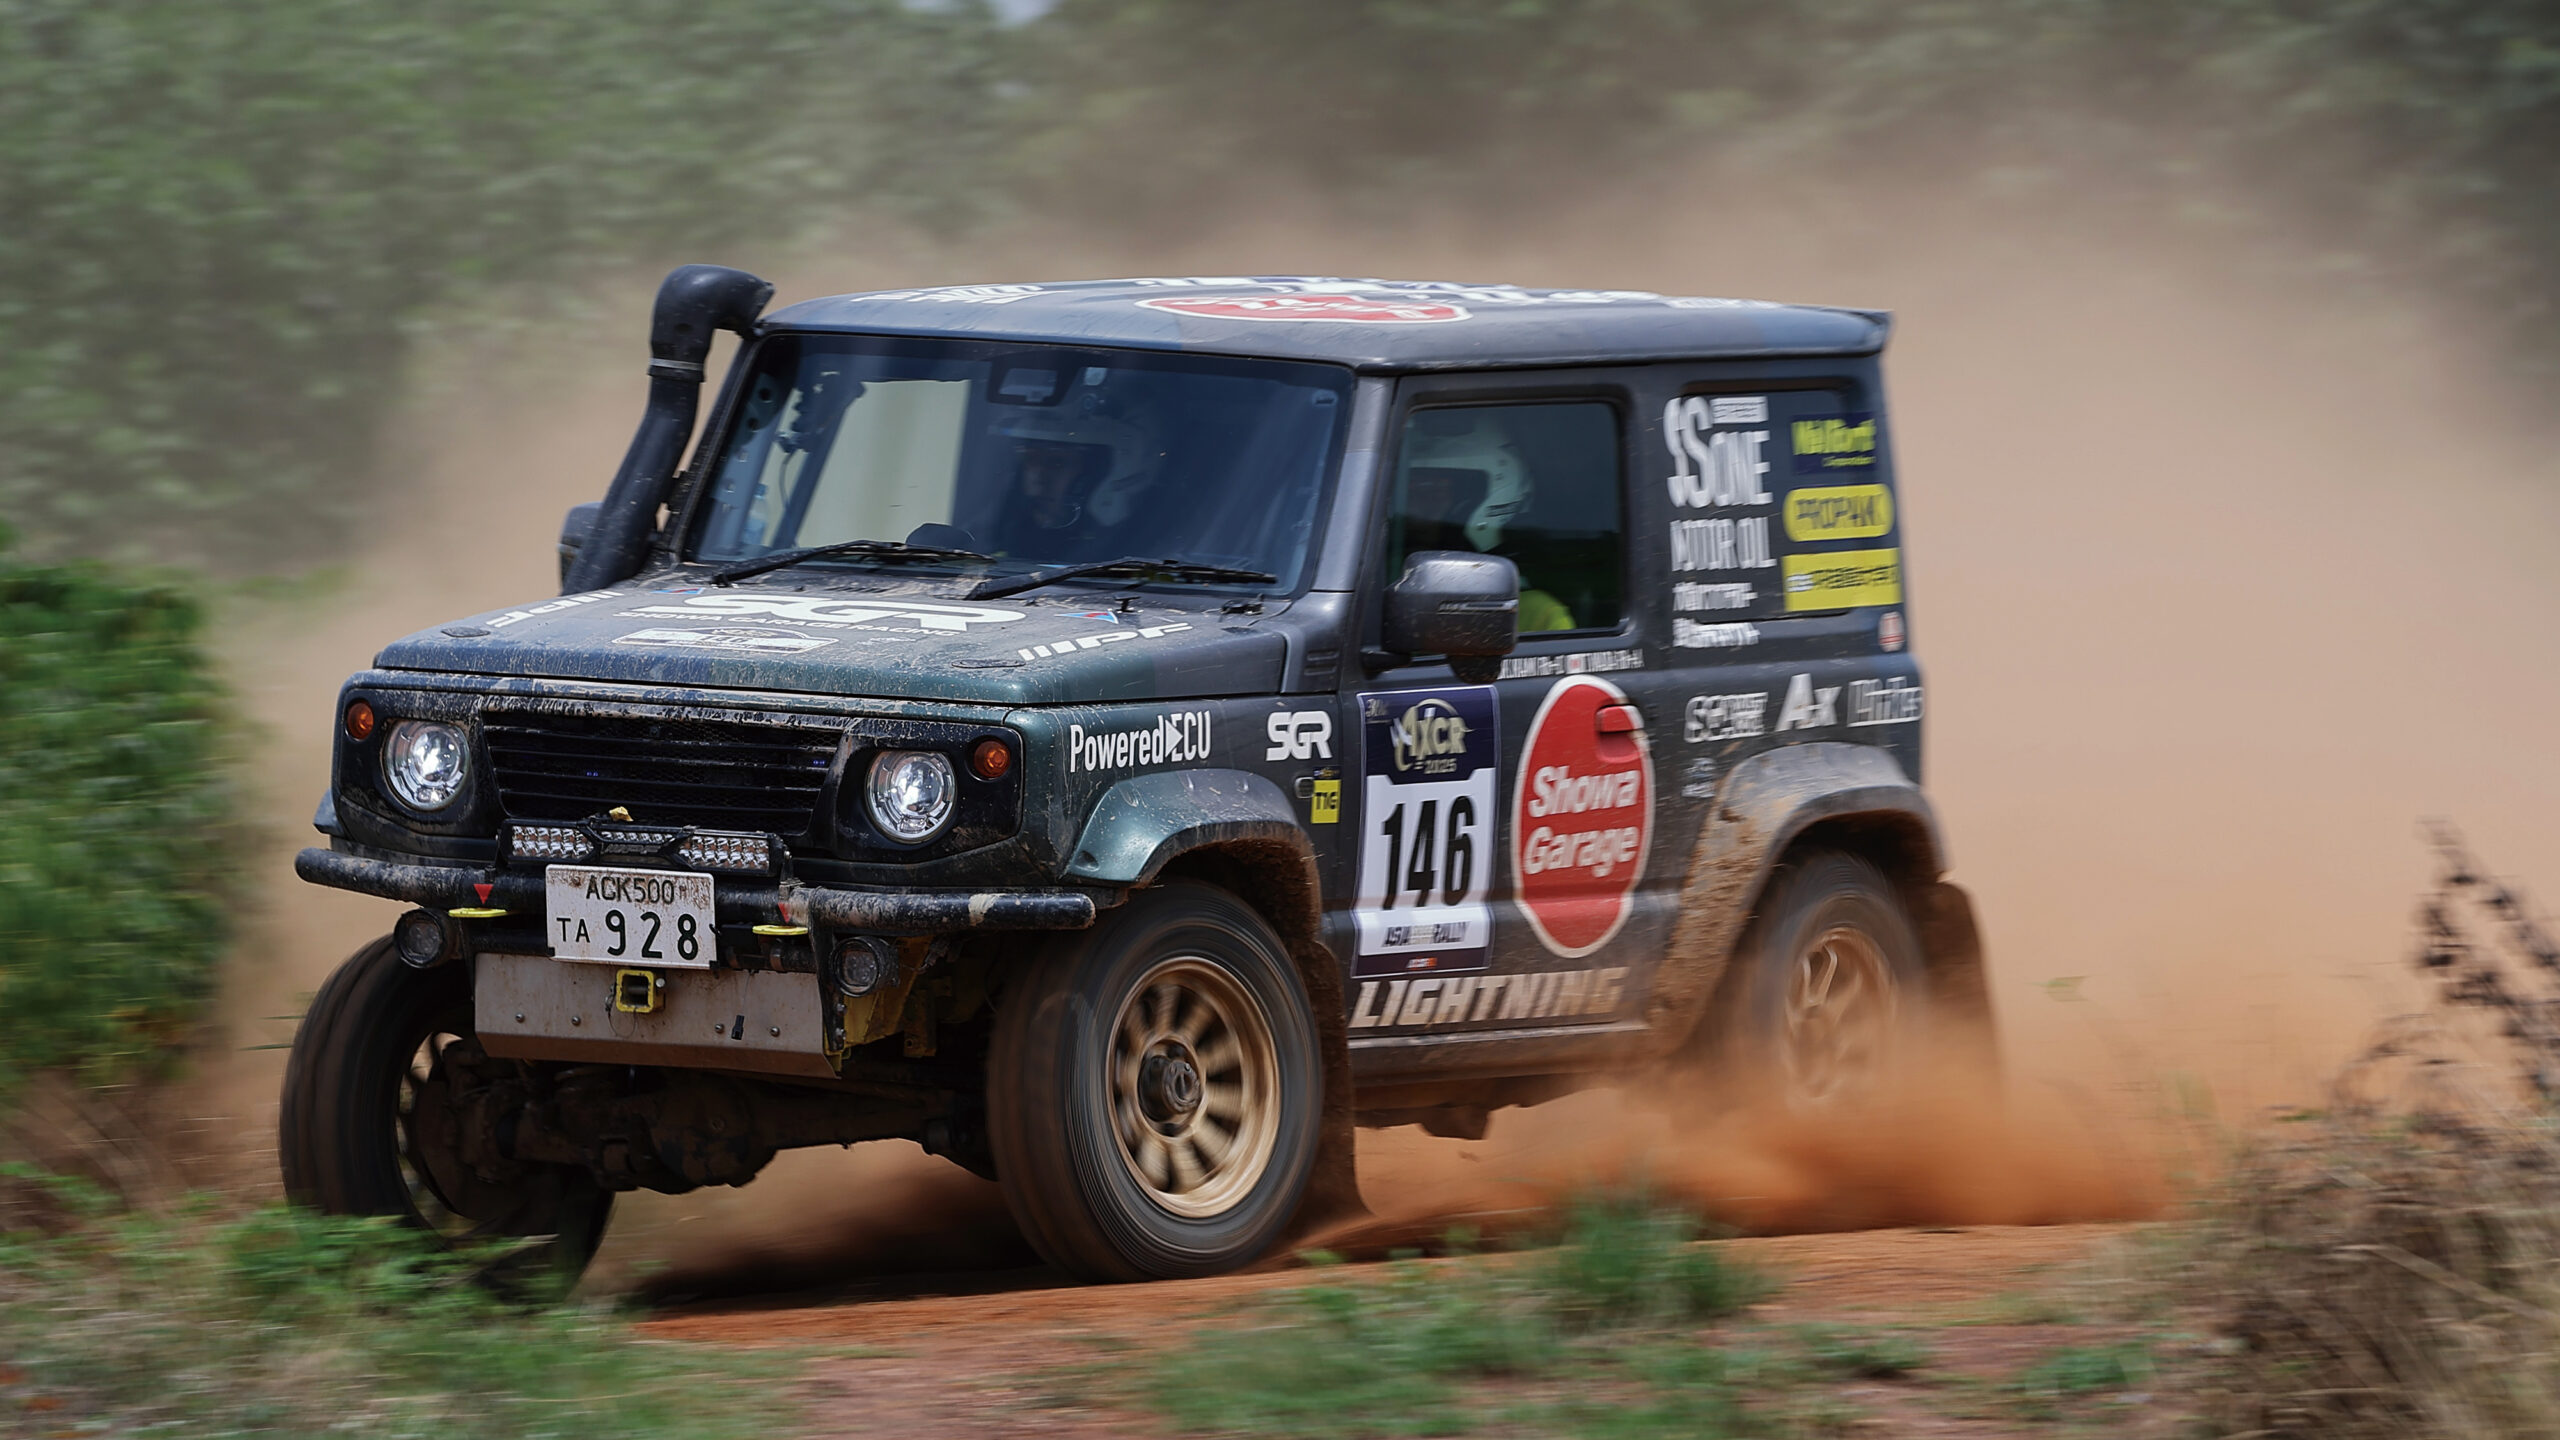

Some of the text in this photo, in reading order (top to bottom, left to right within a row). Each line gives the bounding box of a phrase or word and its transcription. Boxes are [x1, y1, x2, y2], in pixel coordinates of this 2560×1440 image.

[613, 611, 962, 637] SHOWA GARAGE RACING
[1070, 709, 1212, 773] Powered ECU
[1266, 710, 1333, 762] SGR
[1528, 766, 1642, 818] Showa
[1382, 796, 1476, 911] 146
[1524, 825, 1641, 877] Garage
[586, 874, 676, 905] ACK500
[556, 909, 700, 961] TA 928
[1348, 967, 1630, 1029] LIGHTNING
